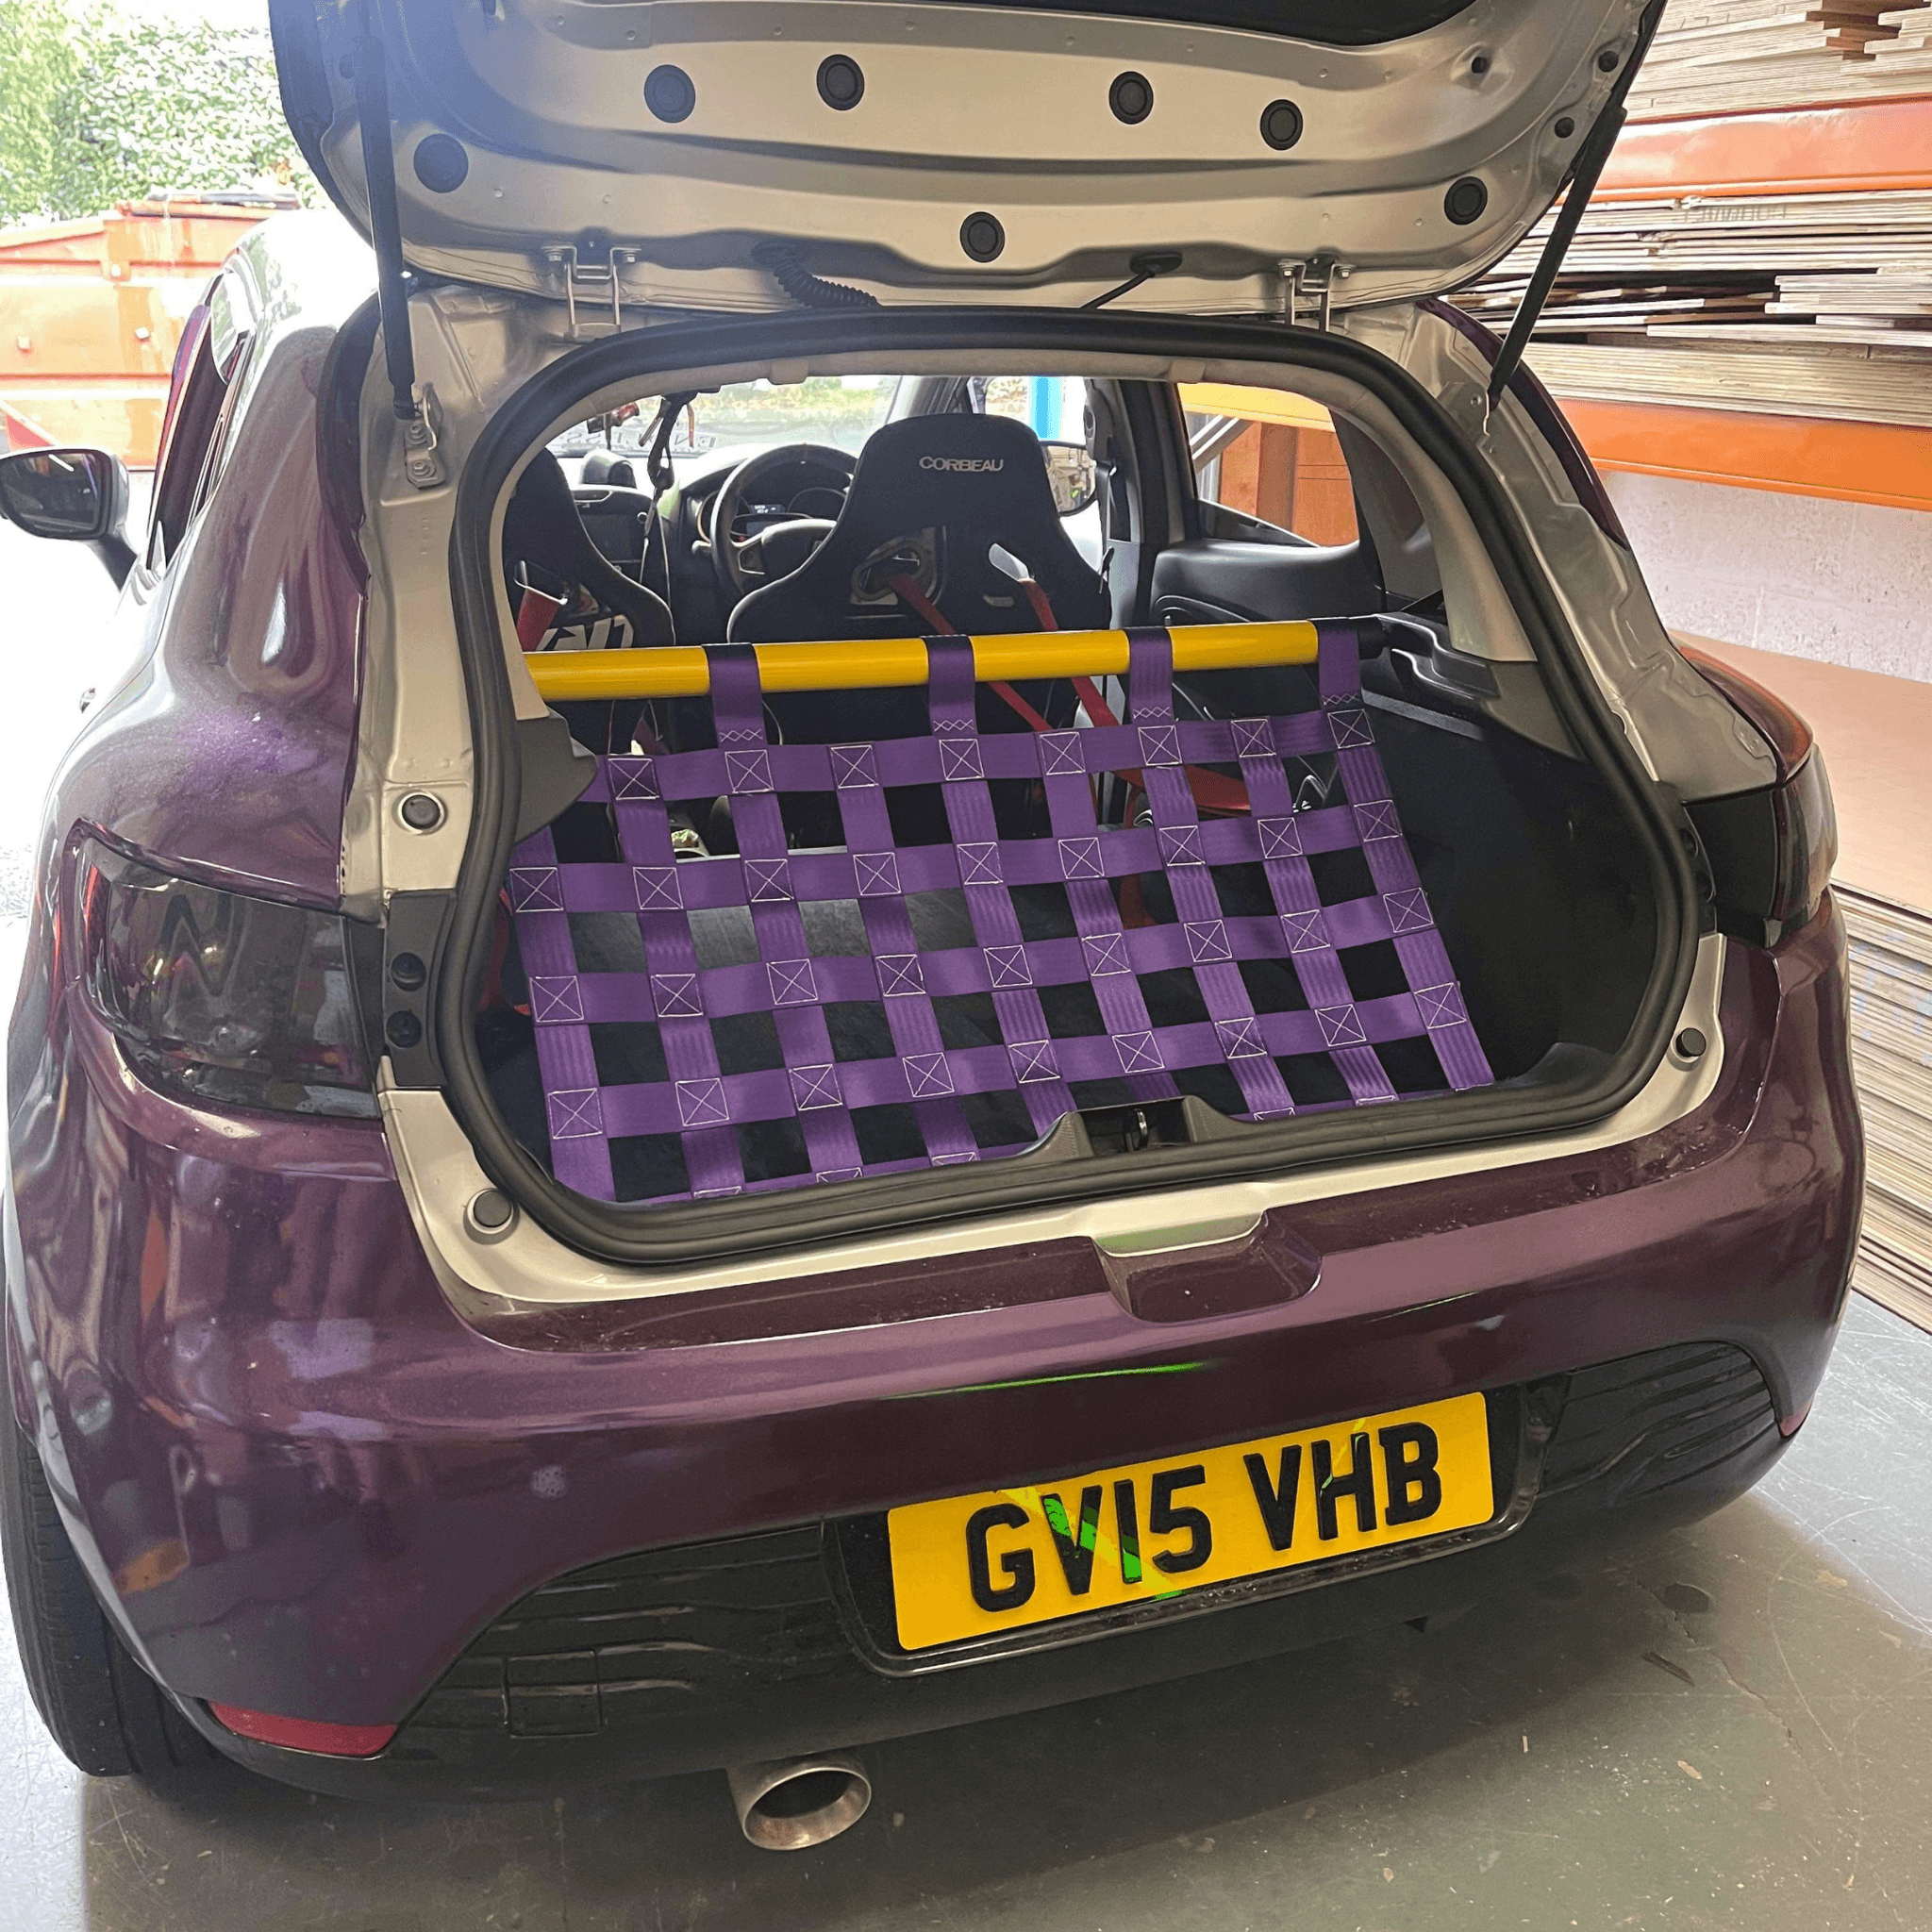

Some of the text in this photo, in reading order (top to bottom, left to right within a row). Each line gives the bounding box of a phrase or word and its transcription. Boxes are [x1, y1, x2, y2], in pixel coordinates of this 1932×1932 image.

[919, 456, 1004, 472] CORBEAU
[964, 1421, 1442, 1613] GV15 VHB
